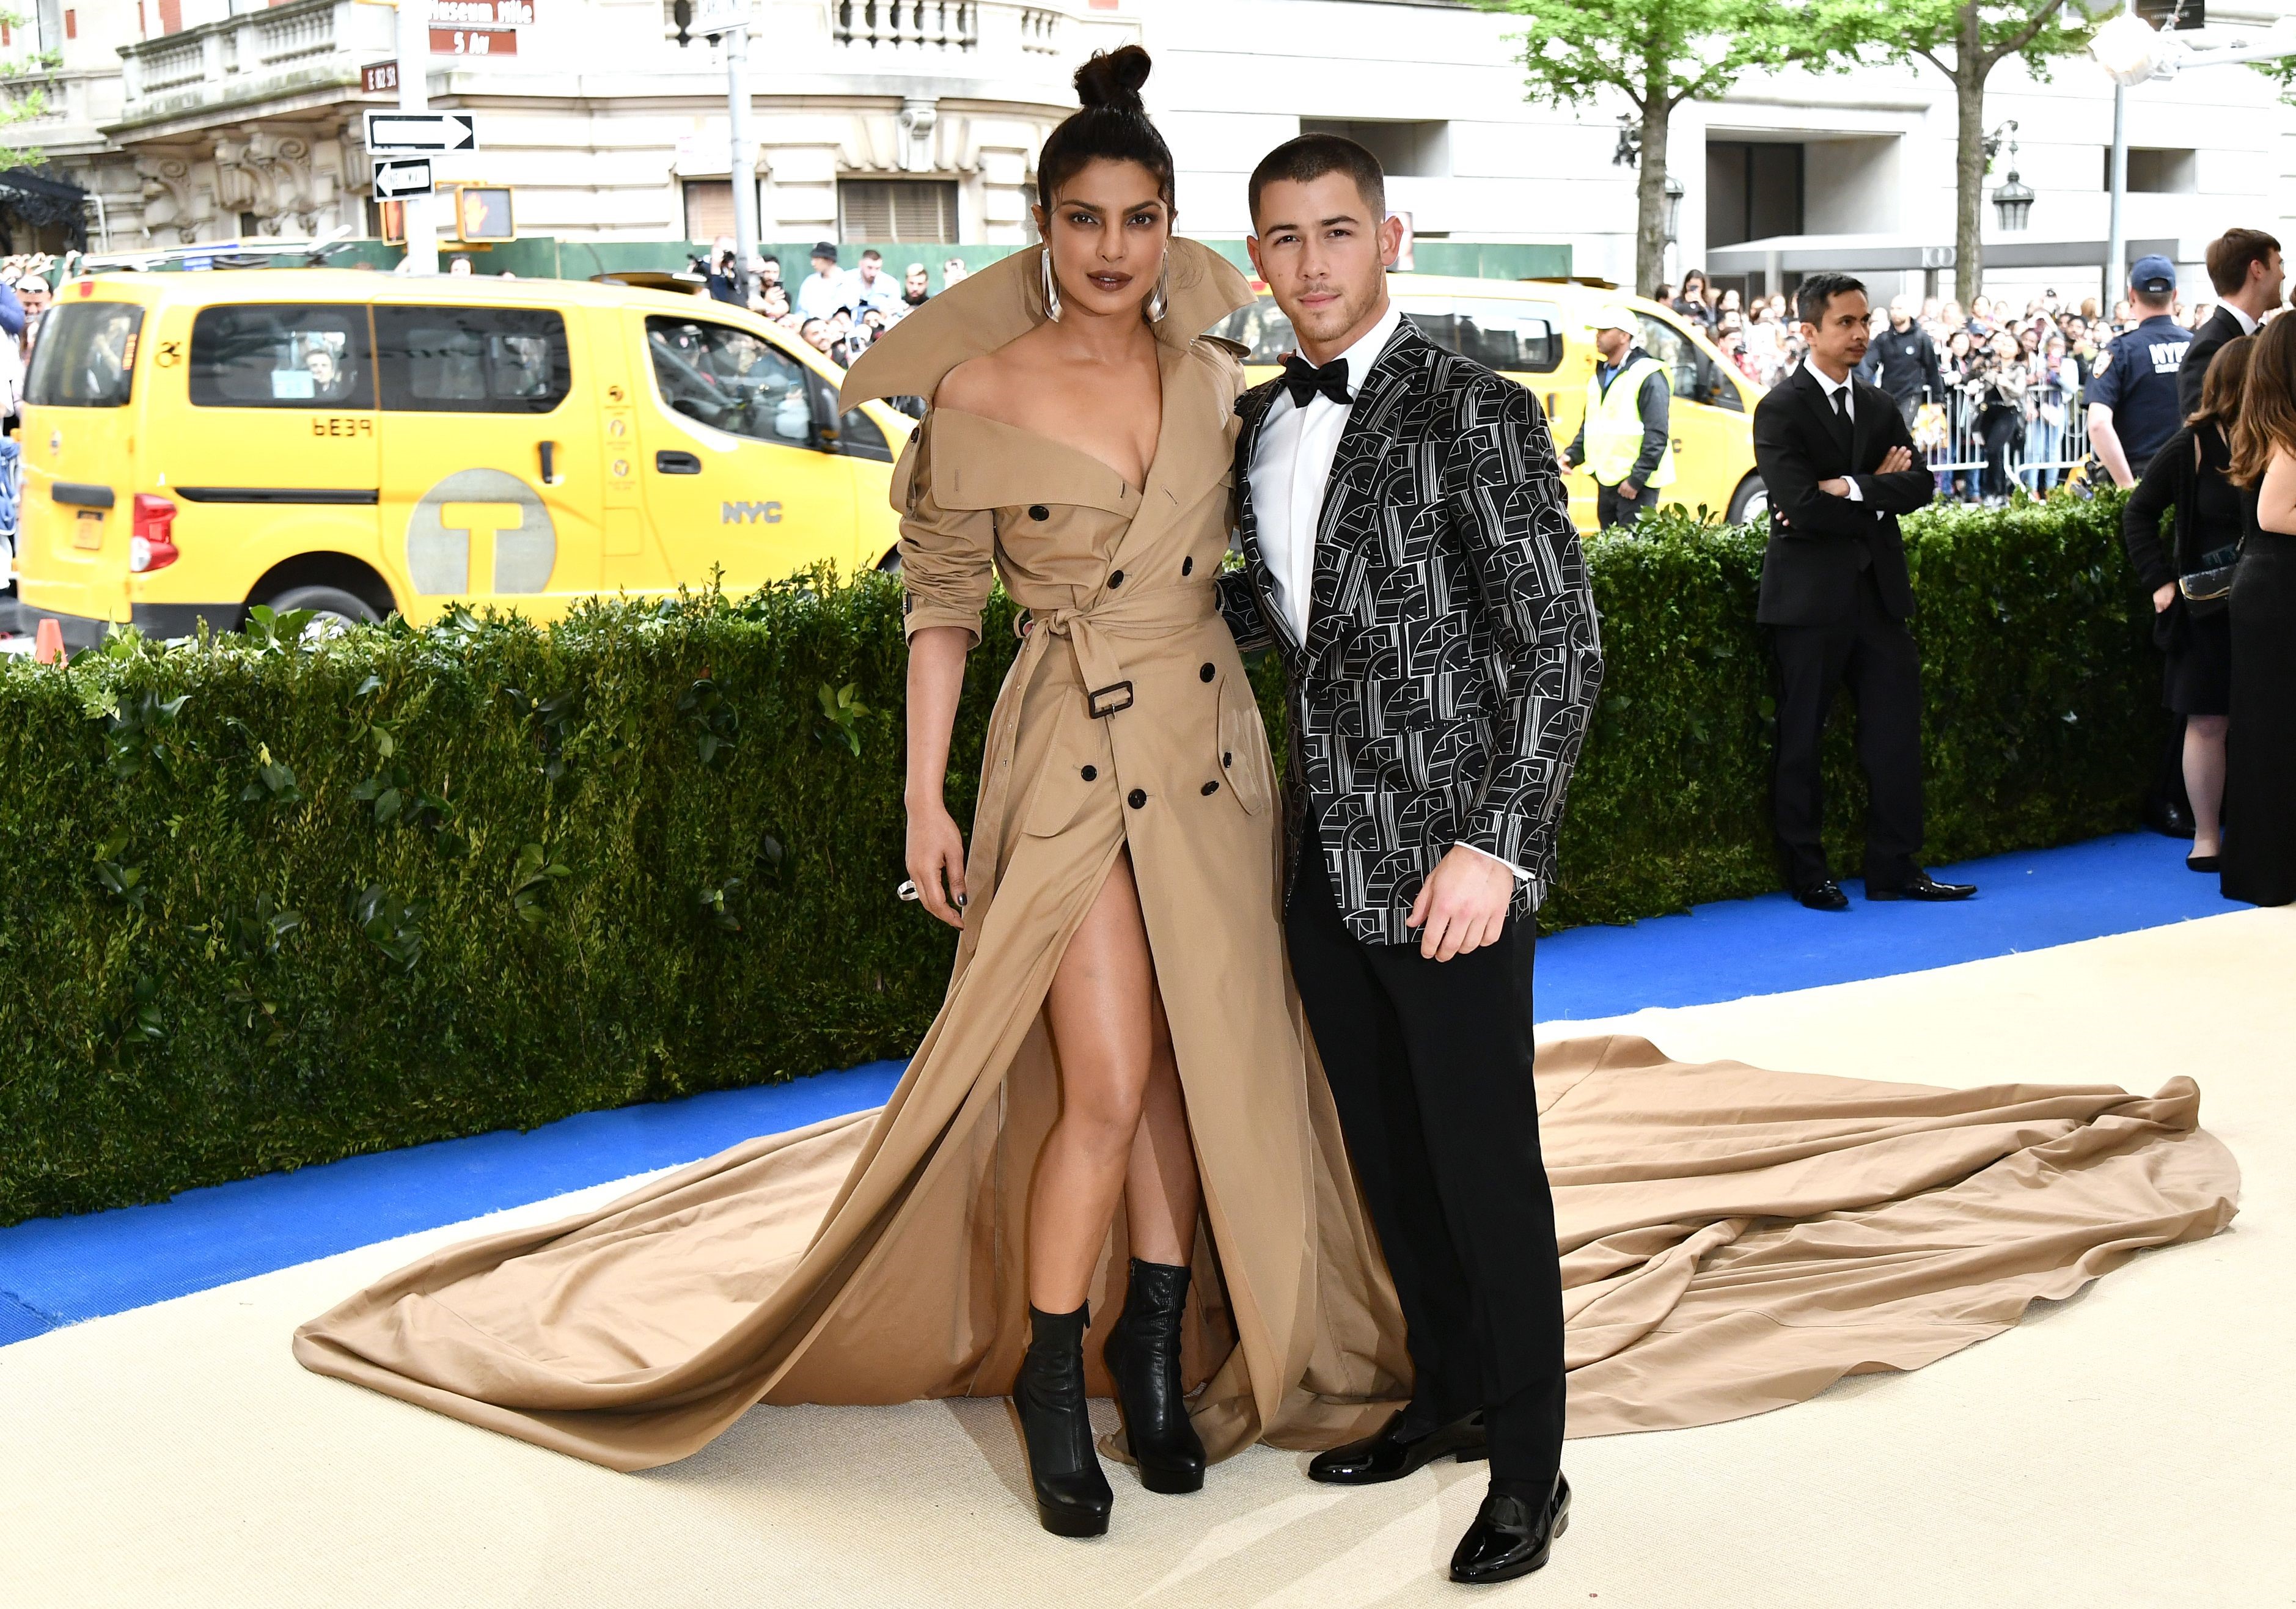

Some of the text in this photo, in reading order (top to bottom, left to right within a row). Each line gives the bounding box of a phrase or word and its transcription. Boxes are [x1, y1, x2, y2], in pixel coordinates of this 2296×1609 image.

[429, 0, 533, 24] Museum Mile
[453, 31, 490, 54] 5 Av
[312, 418, 372, 437] 6E39
[722, 501, 782, 524] NYC
[439, 502, 524, 595] T
